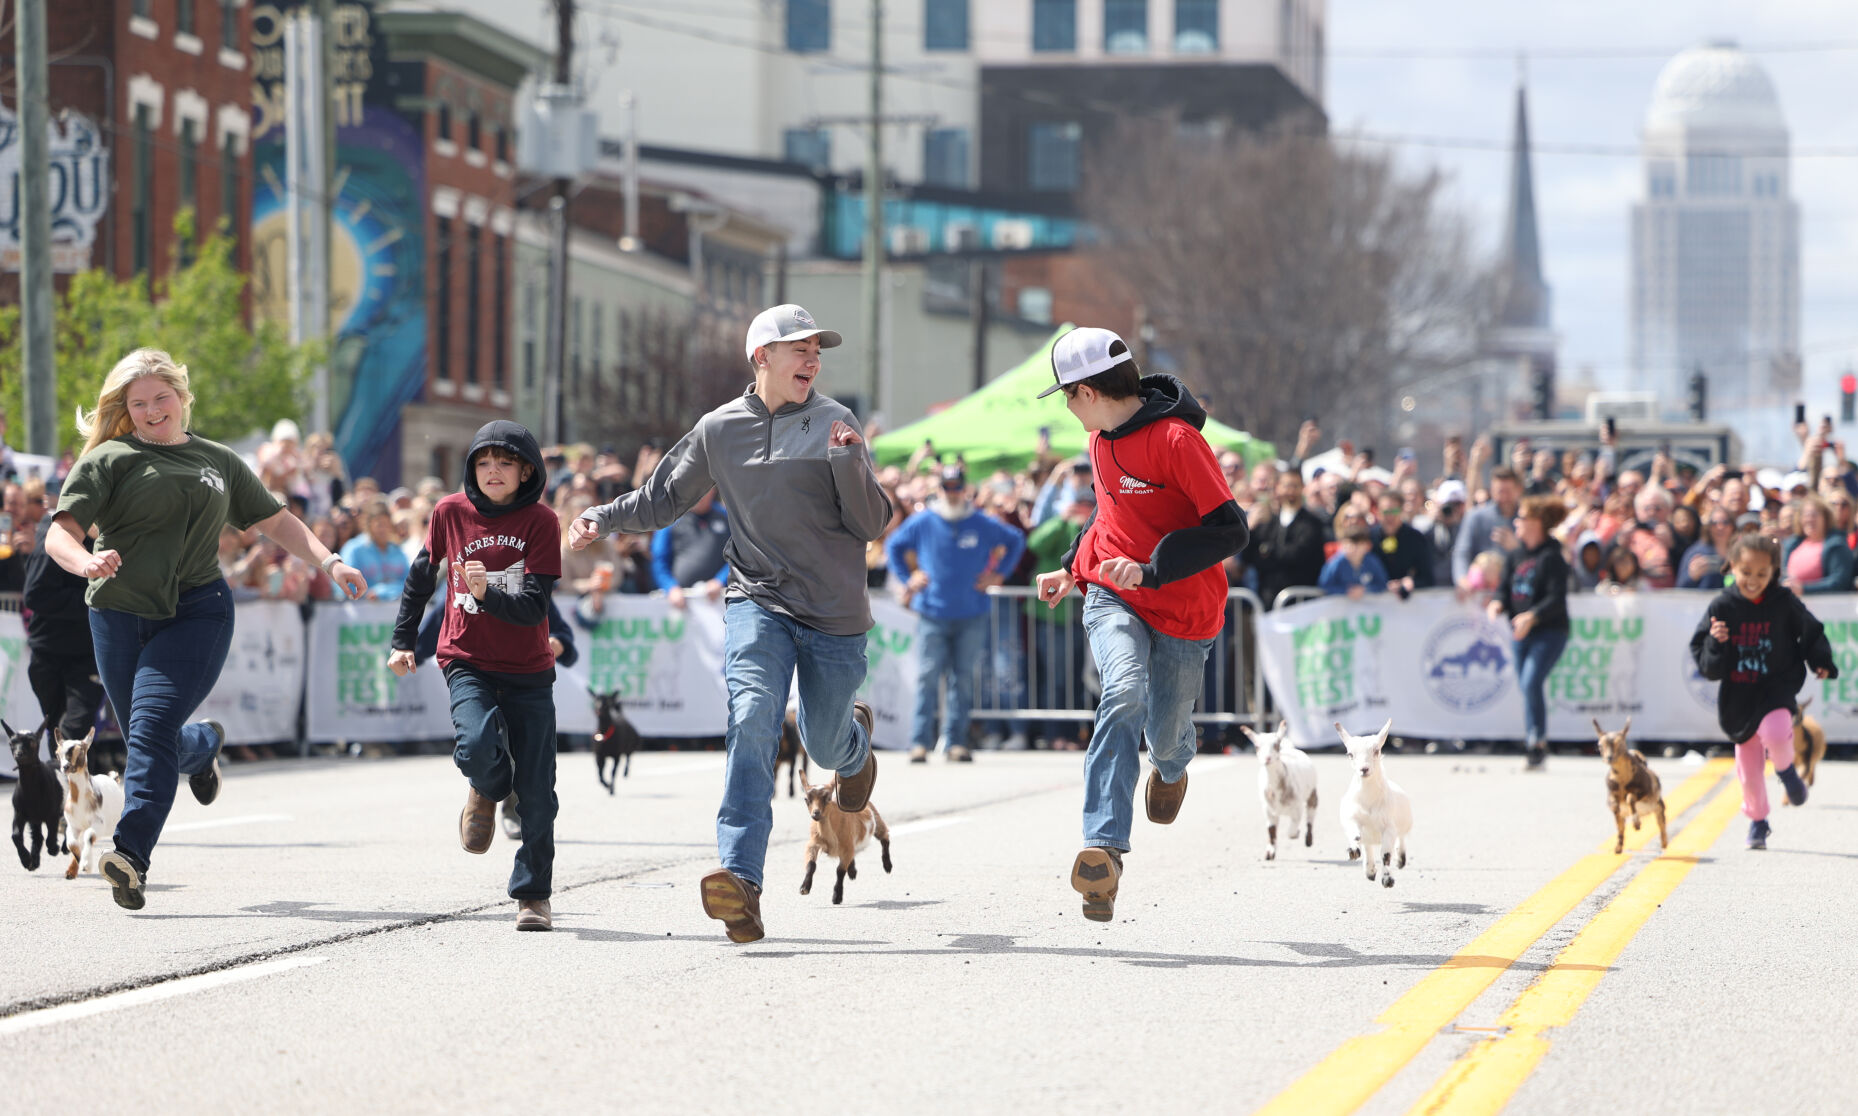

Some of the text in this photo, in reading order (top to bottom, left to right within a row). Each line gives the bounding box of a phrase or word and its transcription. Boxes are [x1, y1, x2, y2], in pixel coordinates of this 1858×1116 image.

[464, 536, 495, 557] ACRES
[496, 534, 526, 552] FARM
[1549, 671, 1610, 700] FEST
